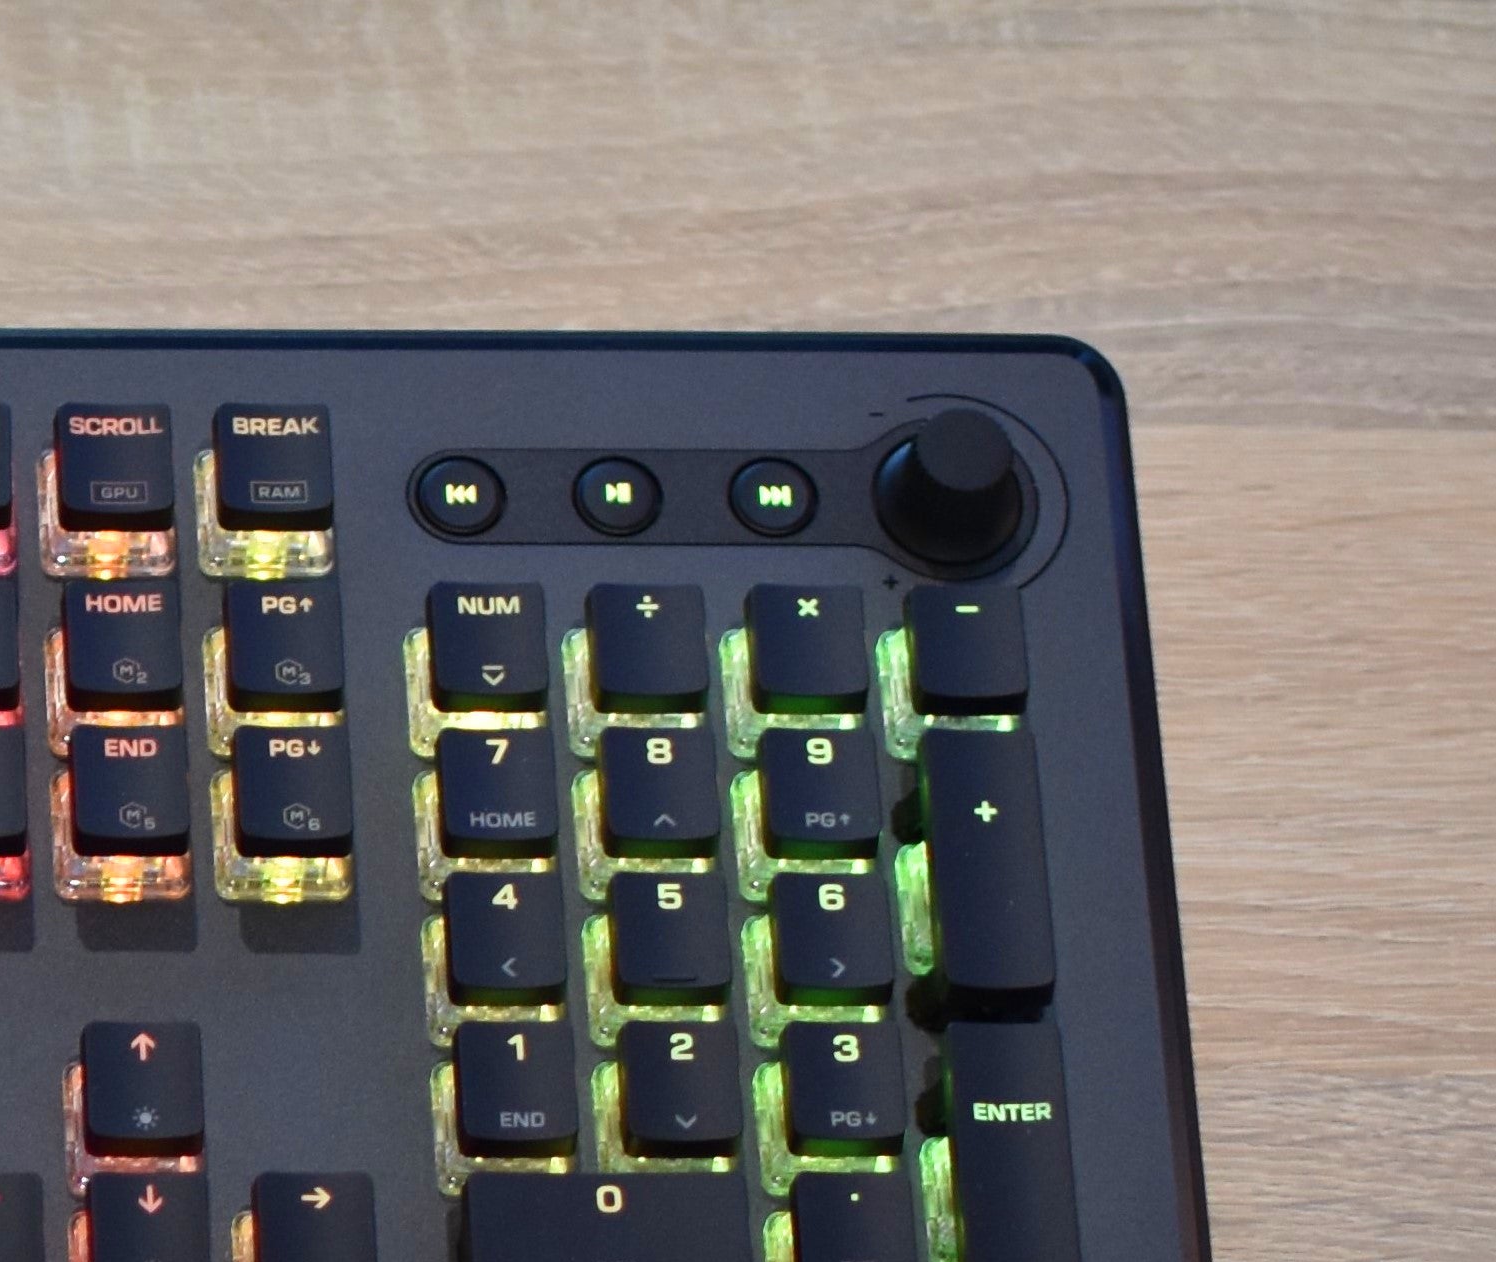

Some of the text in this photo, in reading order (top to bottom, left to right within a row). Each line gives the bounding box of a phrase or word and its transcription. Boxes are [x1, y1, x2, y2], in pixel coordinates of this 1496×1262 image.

[69, 416, 163, 436] SCROLL
[232, 416, 319, 436] BREAK
[100, 486, 139, 500] GPU
[257, 484, 301, 499] RAM
[85, 593, 162, 614] HOME
[457, 595, 521, 616] NUM
[104, 738, 158, 758] END
[485, 738, 509, 765] 7
[646, 737, 673, 765] 8
[806, 737, 834, 765] 9
[469, 810, 537, 828] HOME
[491, 883, 519, 910] 4
[657, 882, 683, 910] 5
[818, 883, 846, 911] 6
[507, 1033, 525, 1061] 1
[669, 1032, 695, 1061] 2
[832, 1034, 860, 1063] 3
[499, 1111, 546, 1128] END
[972, 1101, 1052, 1122] ENTER
[595, 1184, 623, 1214] 0
